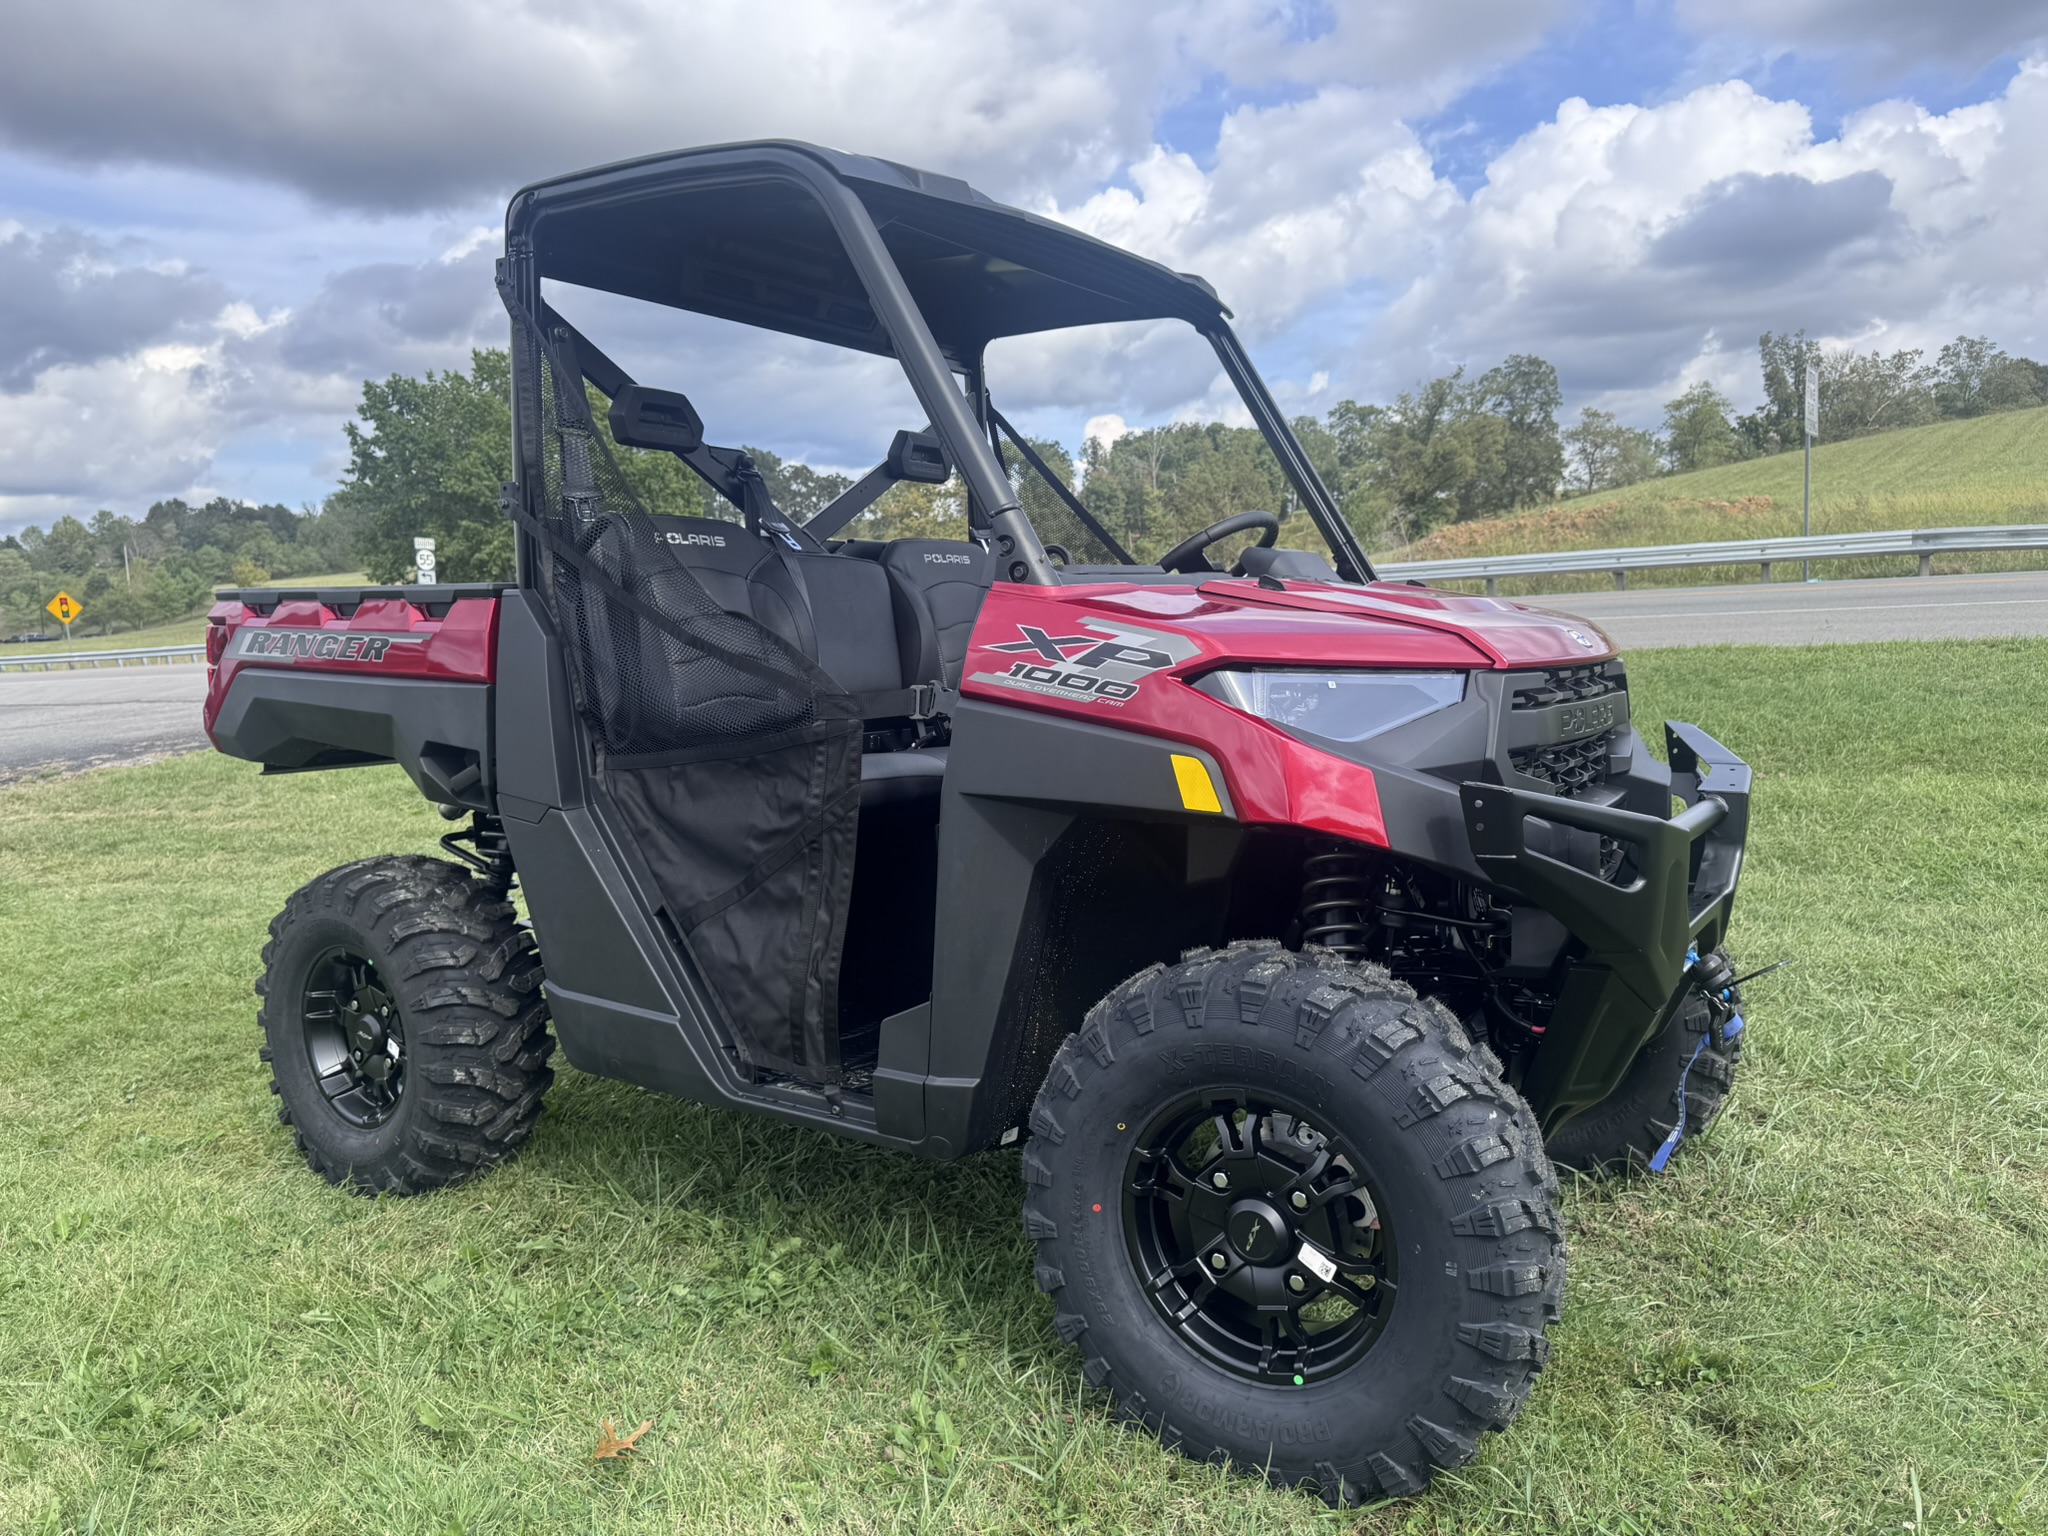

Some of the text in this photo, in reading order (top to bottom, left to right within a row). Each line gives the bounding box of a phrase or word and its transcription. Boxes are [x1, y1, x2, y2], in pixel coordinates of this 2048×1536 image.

[420, 554, 433, 566] 55
[923, 553, 971, 564] POLARIS
[245, 631, 390, 662] RANGER
[979, 624, 1176, 670] XP
[1003, 679, 1125, 708] DUAL OVERHEAD CAM
[1008, 661, 1139, 700] 1000
[1158, 1043, 1335, 1101] X-TERRAIN
[1246, 1218, 1261, 1252] XP
[1179, 1389, 1332, 1444] PRO ARMOR
